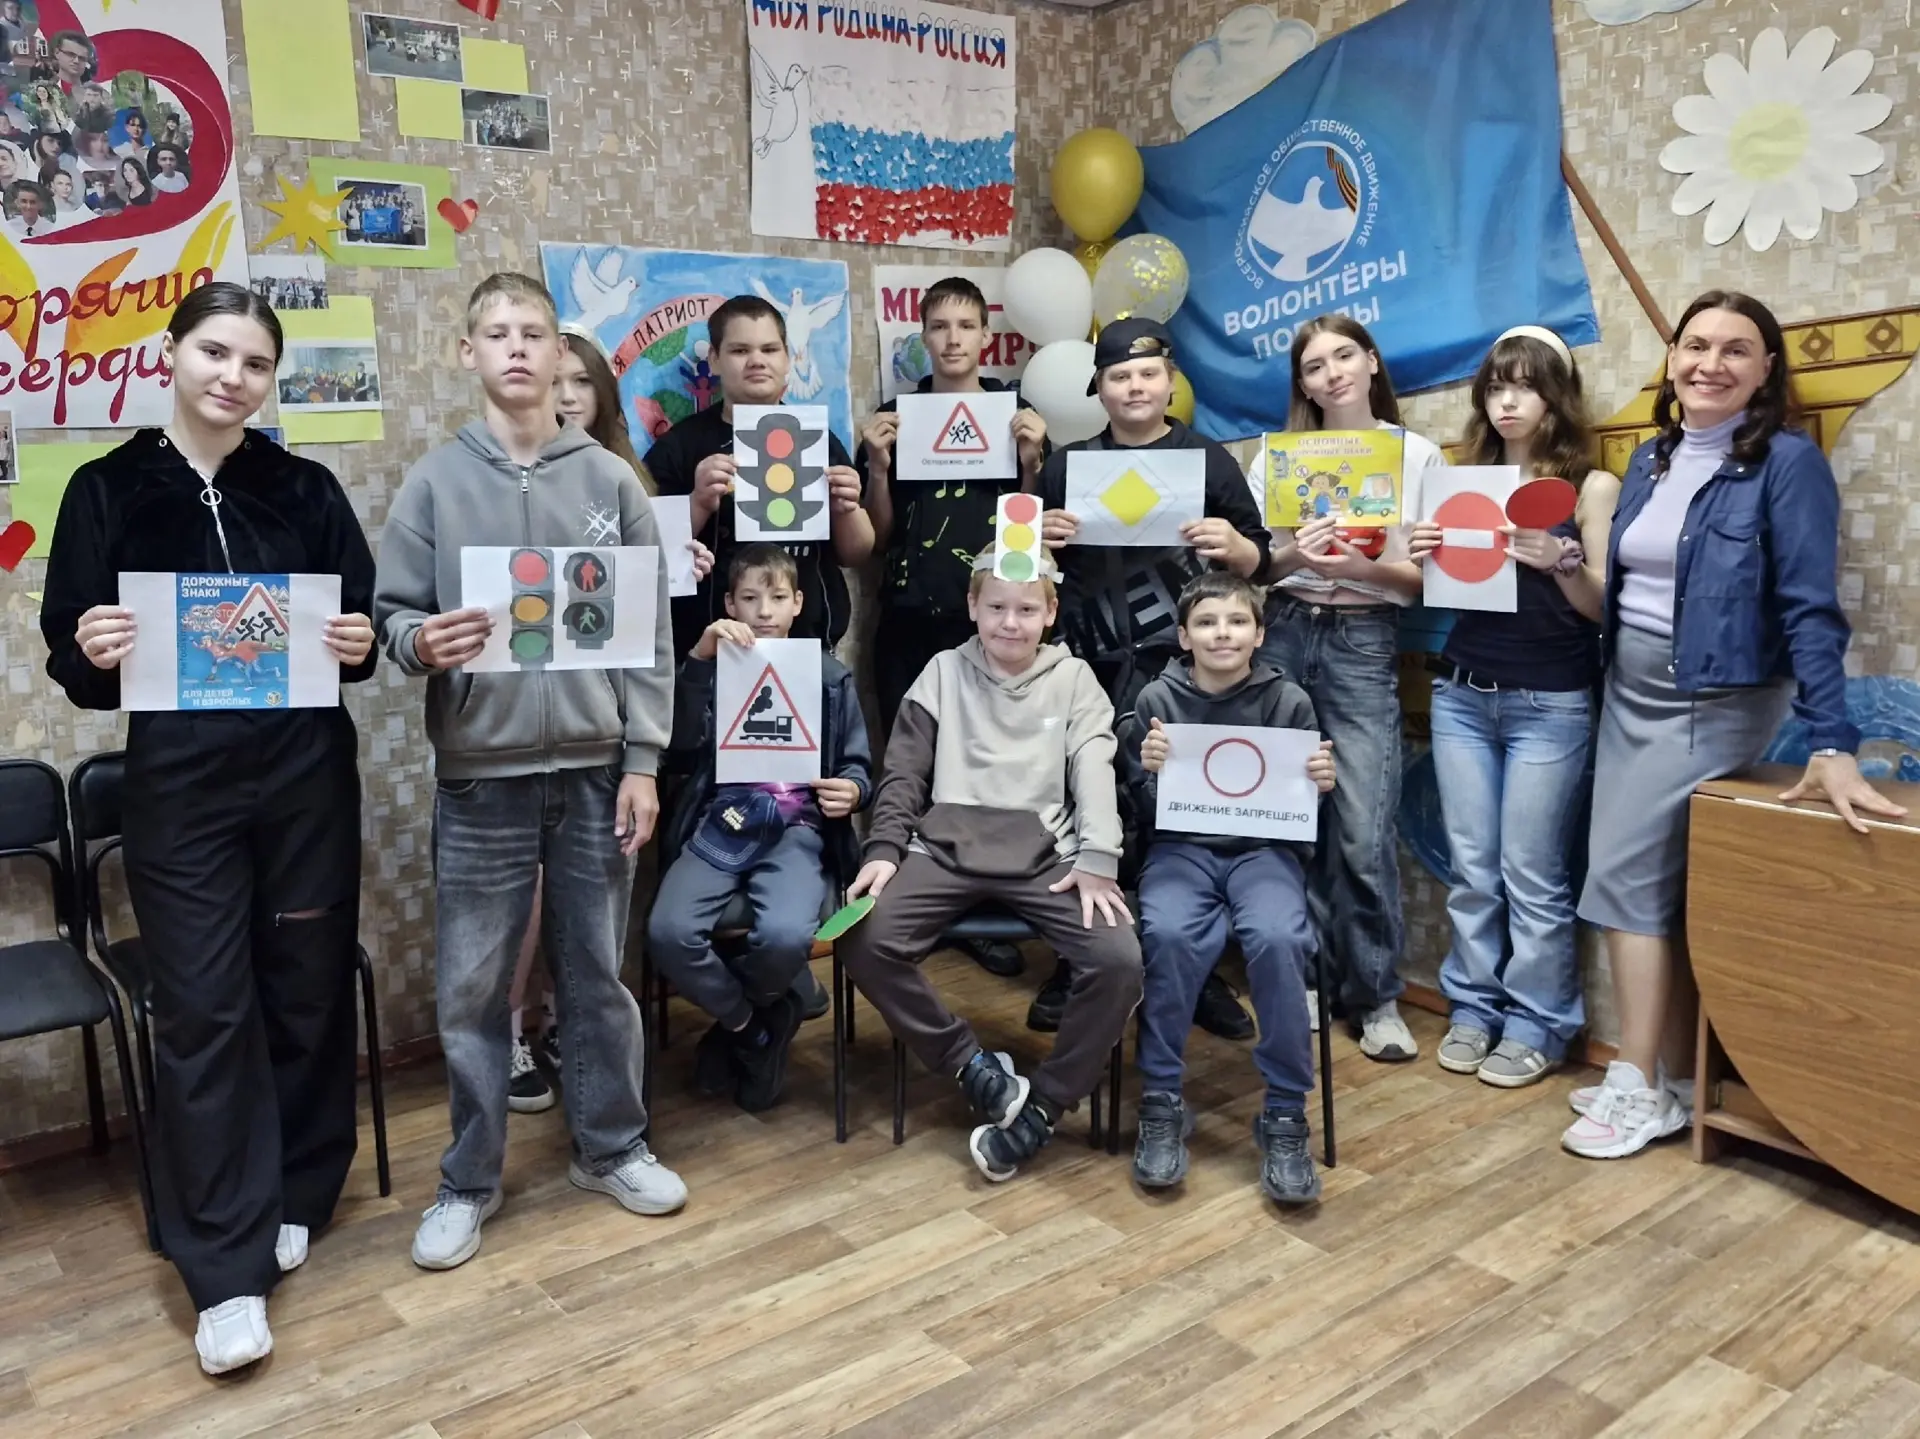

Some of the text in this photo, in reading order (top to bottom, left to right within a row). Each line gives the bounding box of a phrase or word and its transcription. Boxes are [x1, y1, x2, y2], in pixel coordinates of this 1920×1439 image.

[753, 0, 808, 31] МОЯ
[1356, 152, 1380, 248] ДВИЖЕНИЕ
[1223, 249, 1407, 336] ВОЛОНТЁРЫ
[614, 298, 709, 374] Я ПАТРИОТ
[181, 577, 251, 588] ДОРОЖНЫЕ
[181, 588, 221, 598] ЗНАКИ
[1168, 801, 1310, 823] ДВИЖЕНИЕ ЗАПРЕЩЕНО
